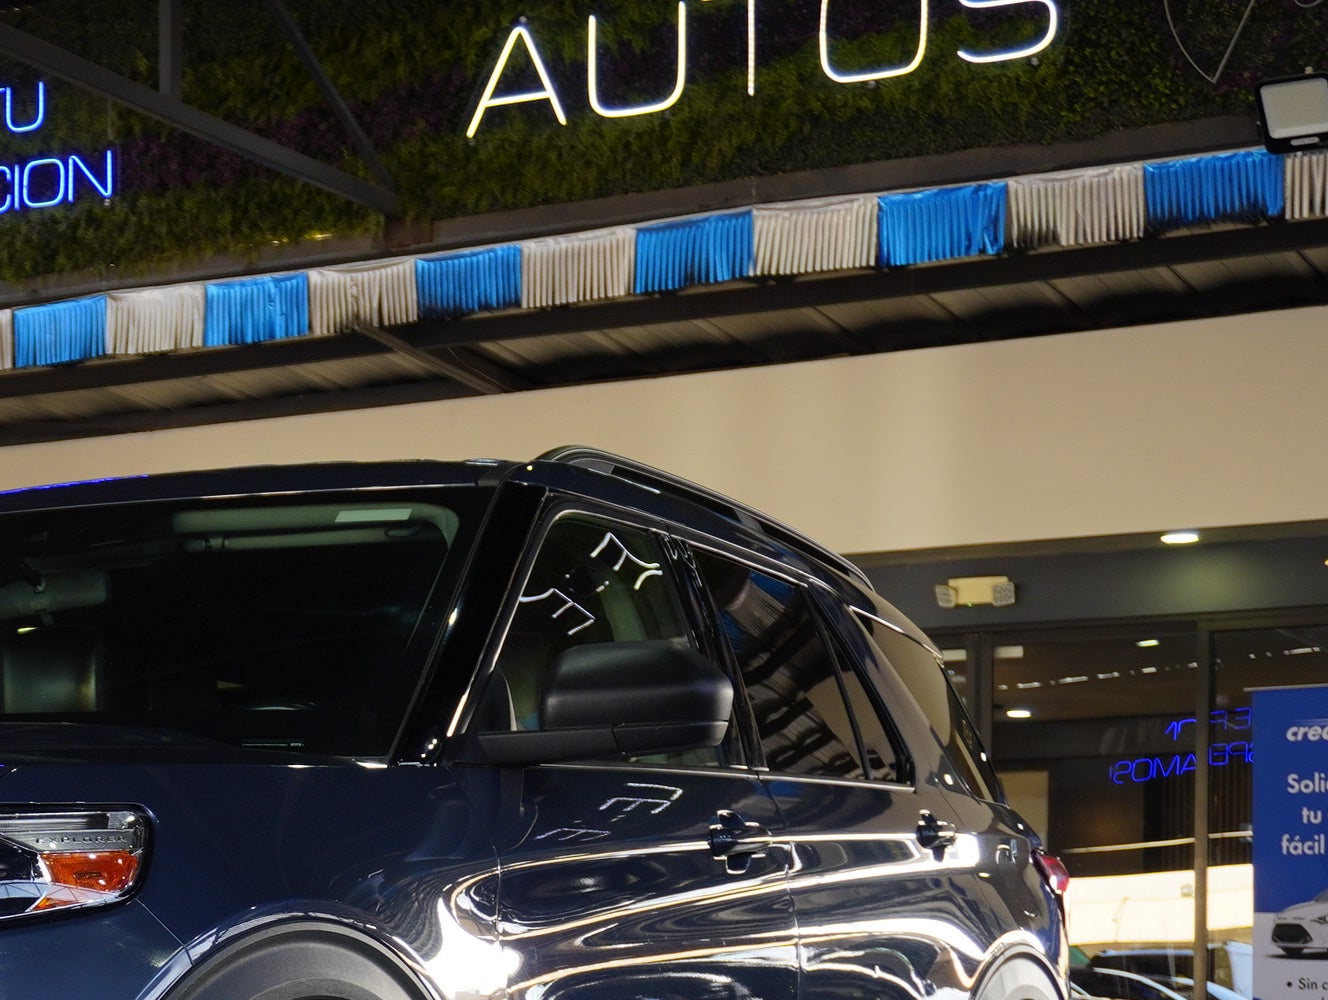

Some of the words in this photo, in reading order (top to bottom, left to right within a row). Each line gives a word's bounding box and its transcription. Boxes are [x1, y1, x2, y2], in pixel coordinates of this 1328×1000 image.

[465, 0, 1059, 139] AUTOS
[1286, 772, 1328, 794] Soli
[1301, 806, 1322, 825] tu
[1280, 833, 1326, 856] fácil
[1298, 977, 1318, 991] Sin
